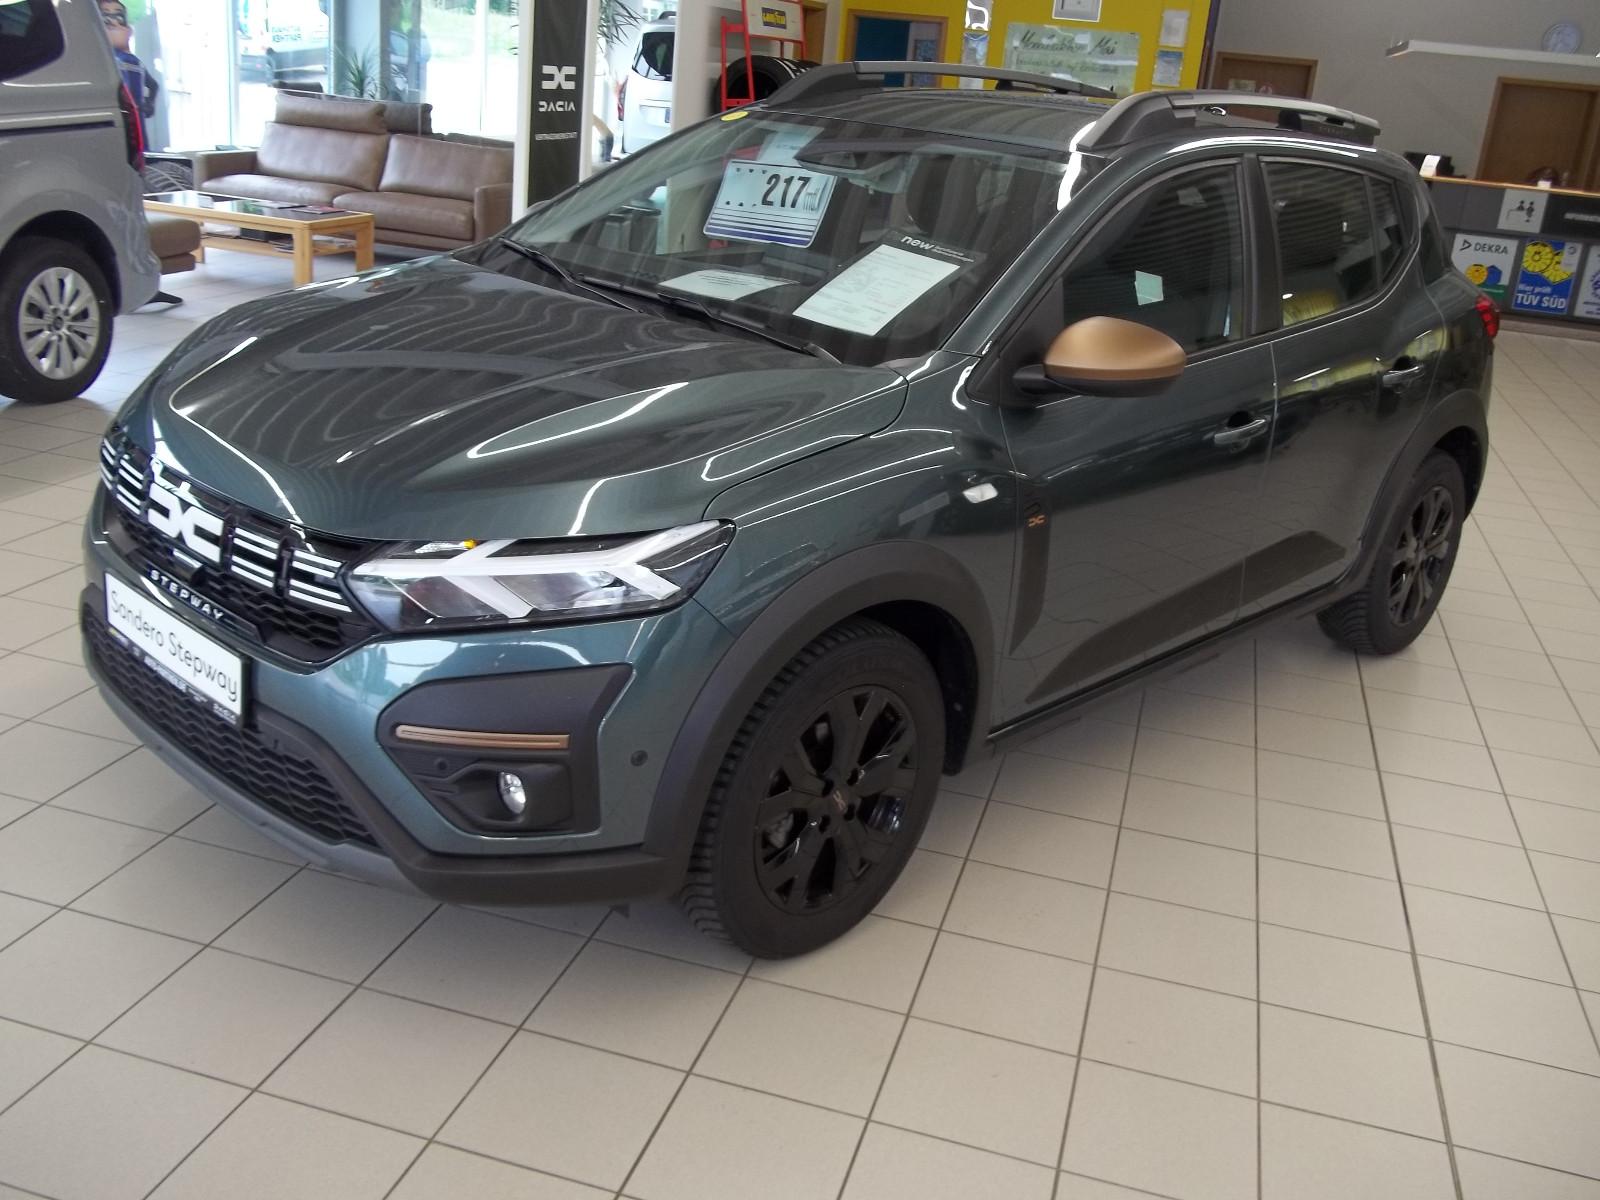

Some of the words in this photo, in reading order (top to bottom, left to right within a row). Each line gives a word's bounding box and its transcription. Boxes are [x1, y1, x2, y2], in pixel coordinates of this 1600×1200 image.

[538, 101, 576, 112] DACIA
[761, 173, 813, 209] 217
[900, 235, 936, 250] new
[1473, 242, 1509, 255] DEKRA
[1515, 292, 1540, 306] TÜV
[1541, 295, 1567, 309] SÜD
[150, 569, 225, 620] STEPWAY
[110, 590, 165, 647] Sandero
[168, 632, 238, 703] Stepway
